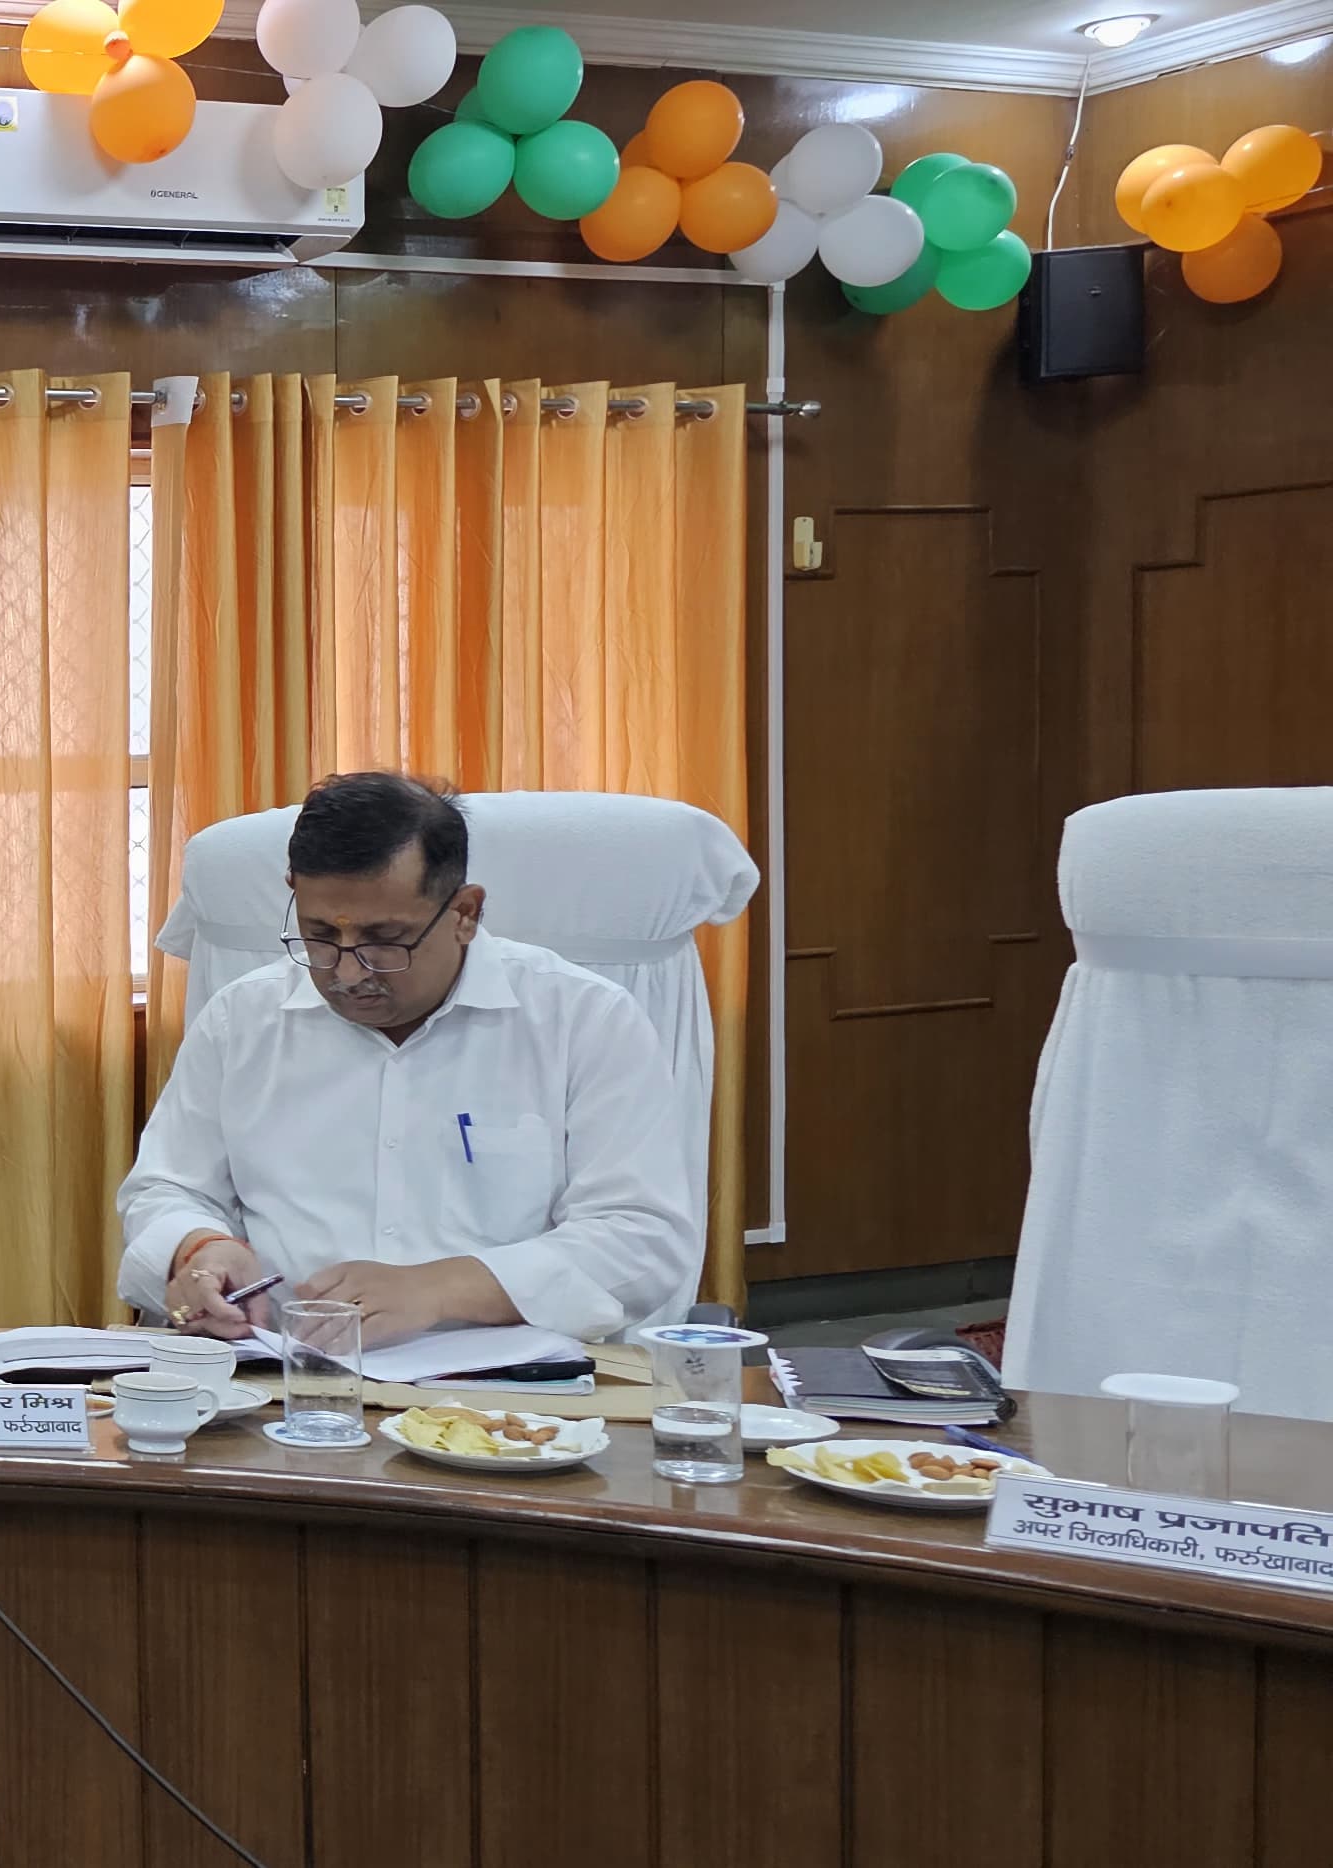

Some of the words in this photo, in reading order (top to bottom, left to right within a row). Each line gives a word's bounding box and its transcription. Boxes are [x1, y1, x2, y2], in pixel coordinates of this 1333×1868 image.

[21, 1392, 75, 1409] मिश्र
[1012, 1518, 1063, 1539] अपर
[1068, 1521, 1205, 1561] जिलाधिकारी,
[1022, 1493, 1144, 1521] सुभाष
[1155, 1509, 1333, 1549] प्रजापति
